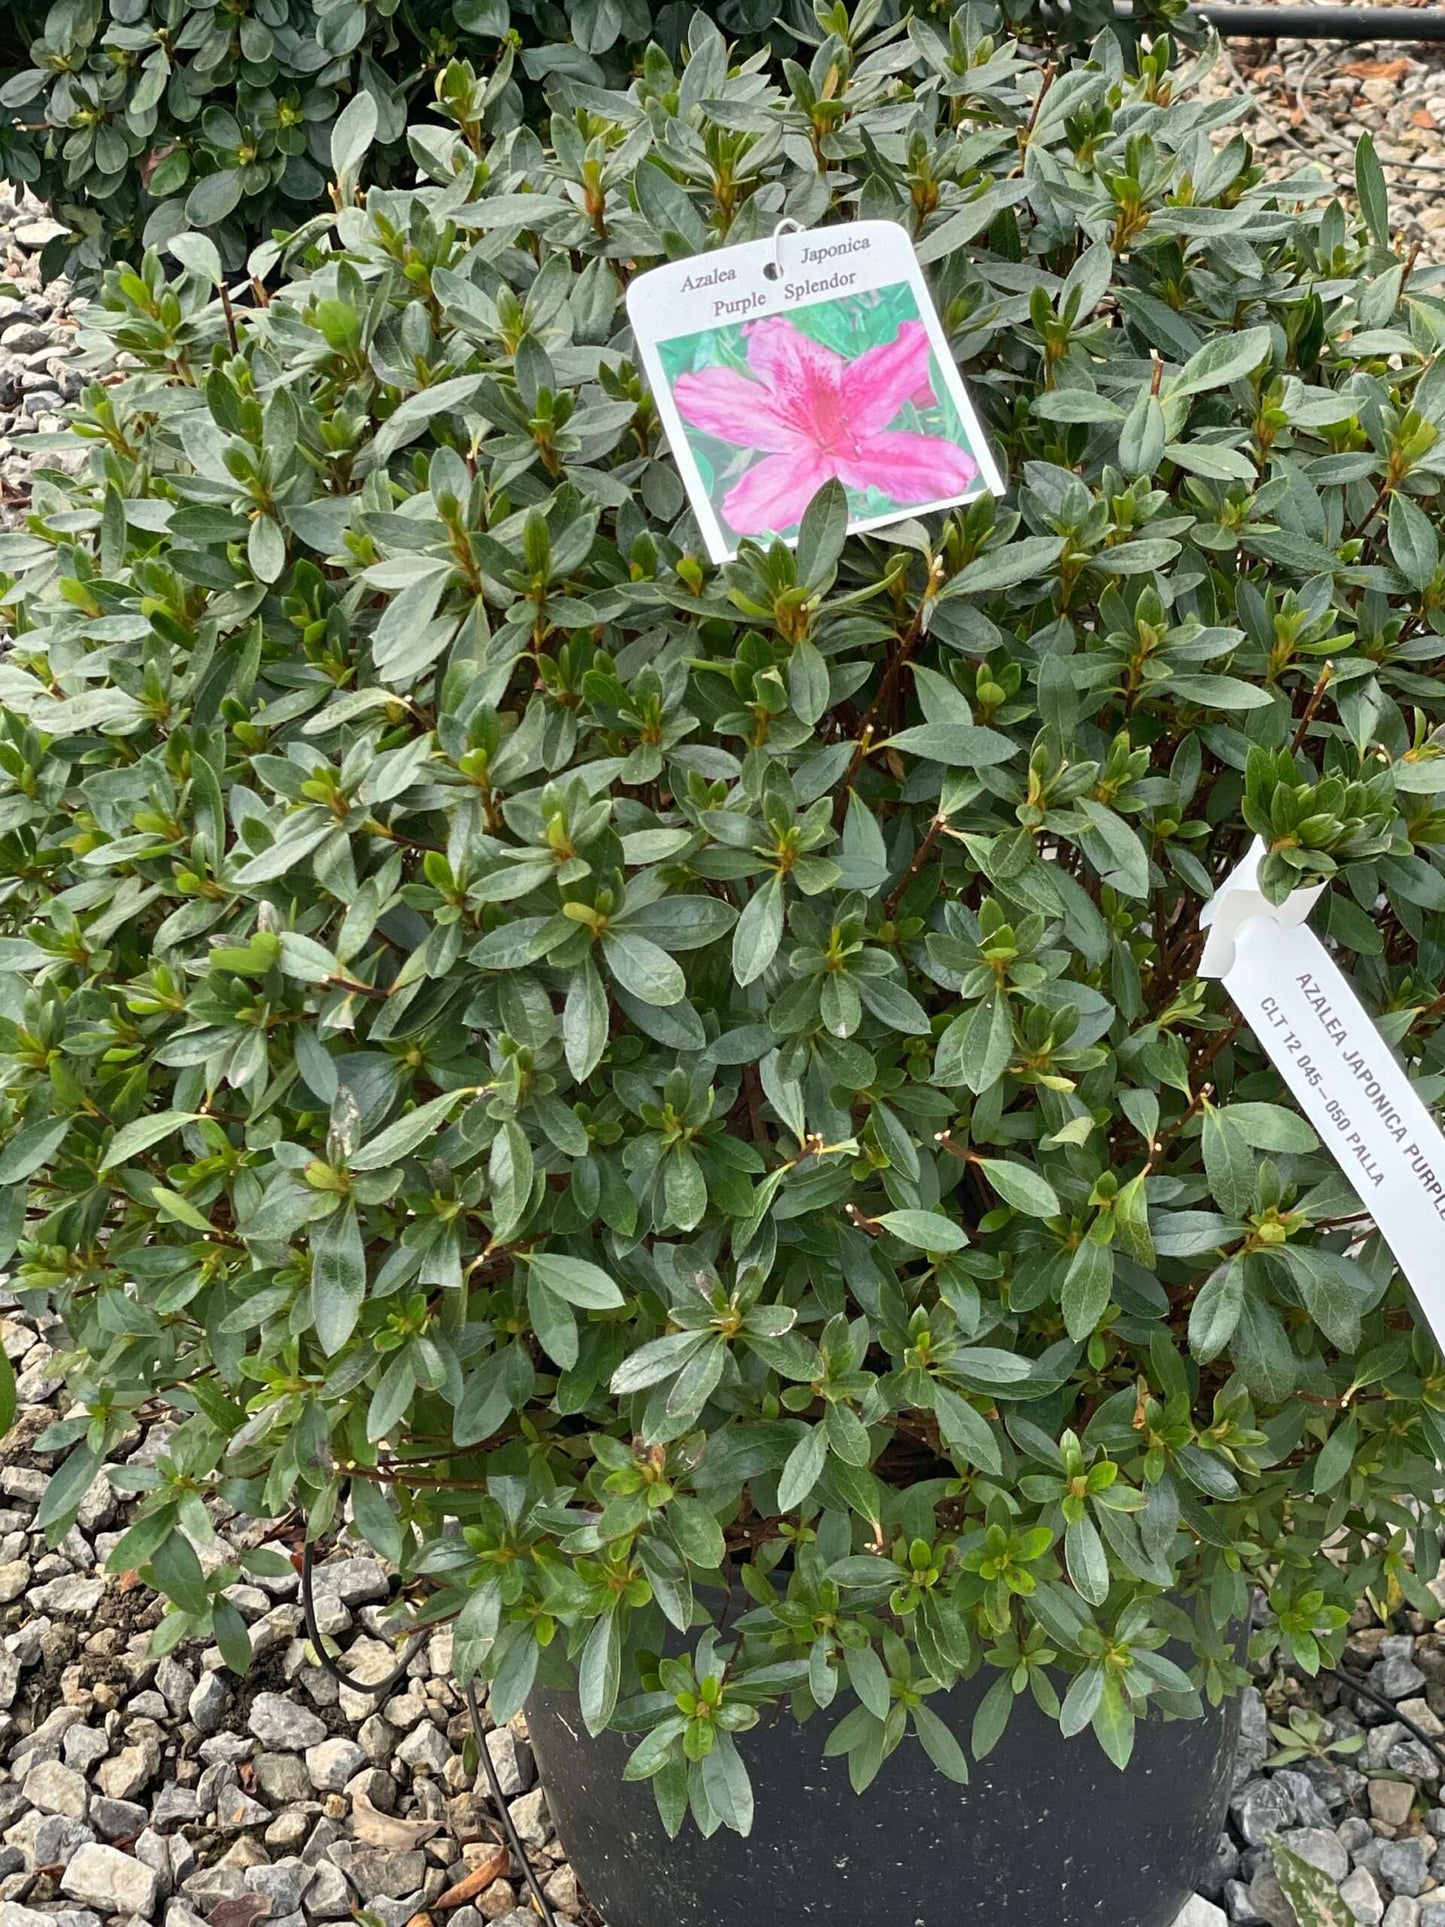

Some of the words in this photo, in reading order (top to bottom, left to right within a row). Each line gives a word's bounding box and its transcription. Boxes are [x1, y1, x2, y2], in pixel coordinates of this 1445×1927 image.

[680, 268, 737, 292] Azalea
[801, 237, 871, 264] Japonica
[713, 292, 767, 317] Purple
[784, 272, 857, 301] Splendor
[1260, 996, 1288, 1028] CLT
[1283, 1030, 1302, 1054] 12
[1346, 1132, 1385, 1188] PALLA
[1296, 973, 1348, 1047] AZALEA
[1343, 1050, 1408, 1143] JAPONICA
